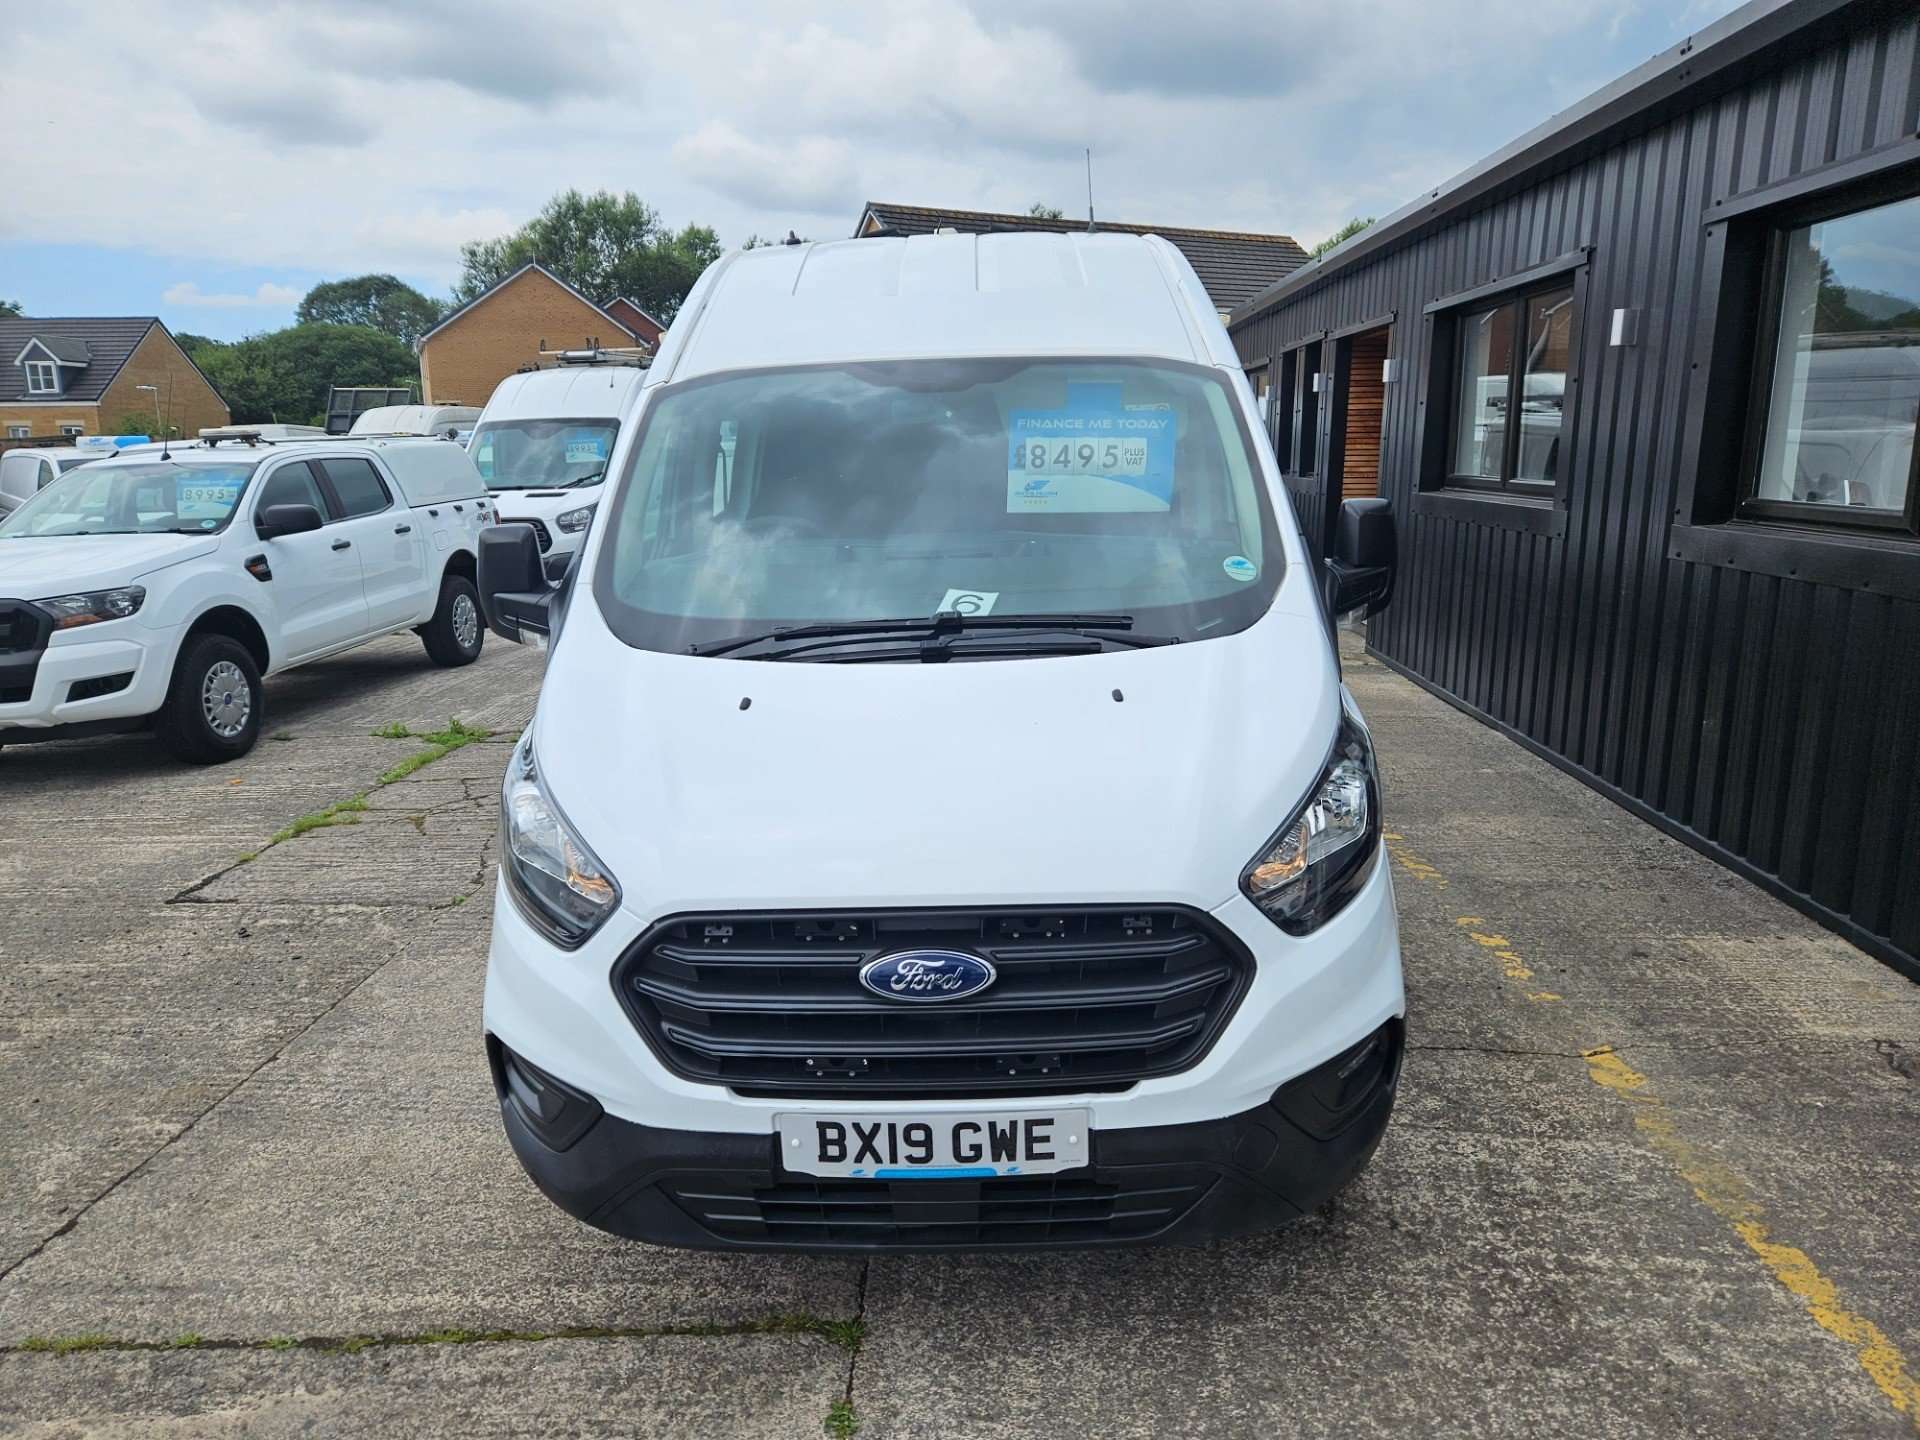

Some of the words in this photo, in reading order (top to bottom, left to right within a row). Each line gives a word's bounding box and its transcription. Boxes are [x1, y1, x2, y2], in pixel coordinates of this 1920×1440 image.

[1016, 418, 1083, 429] FINANCE
[1088, 418, 1113, 429] ME
[1118, 418, 1169, 429] TODAY
[1124, 447, 1145, 456] PLUS
[1125, 457, 1144, 466] VAT
[184, 488, 225, 500] 8995
[890, 959, 964, 991] Ford
[815, 1120, 934, 1165] BX19
[951, 1117, 1056, 1164] GWE
